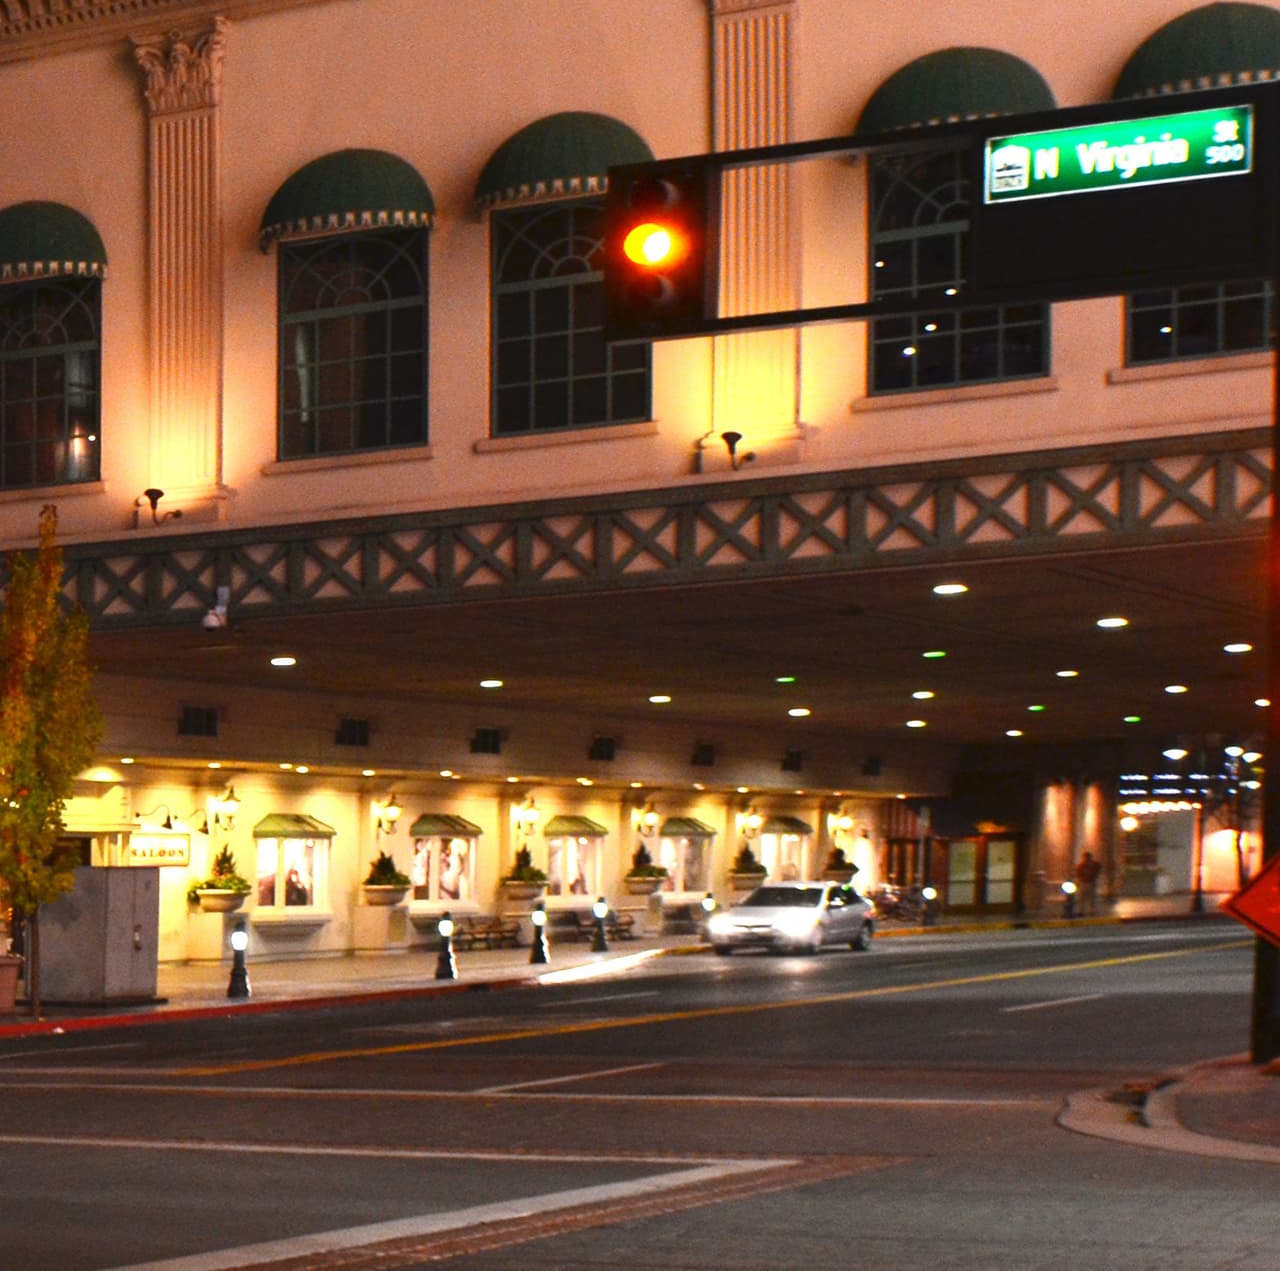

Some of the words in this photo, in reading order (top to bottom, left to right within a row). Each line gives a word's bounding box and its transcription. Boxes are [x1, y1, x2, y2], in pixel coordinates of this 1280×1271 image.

[1213, 119, 1239, 143] St
[1034, 146, 1060, 180] N
[1076, 132, 1190, 178] Virginia
[1205, 144, 1245, 165] 500
